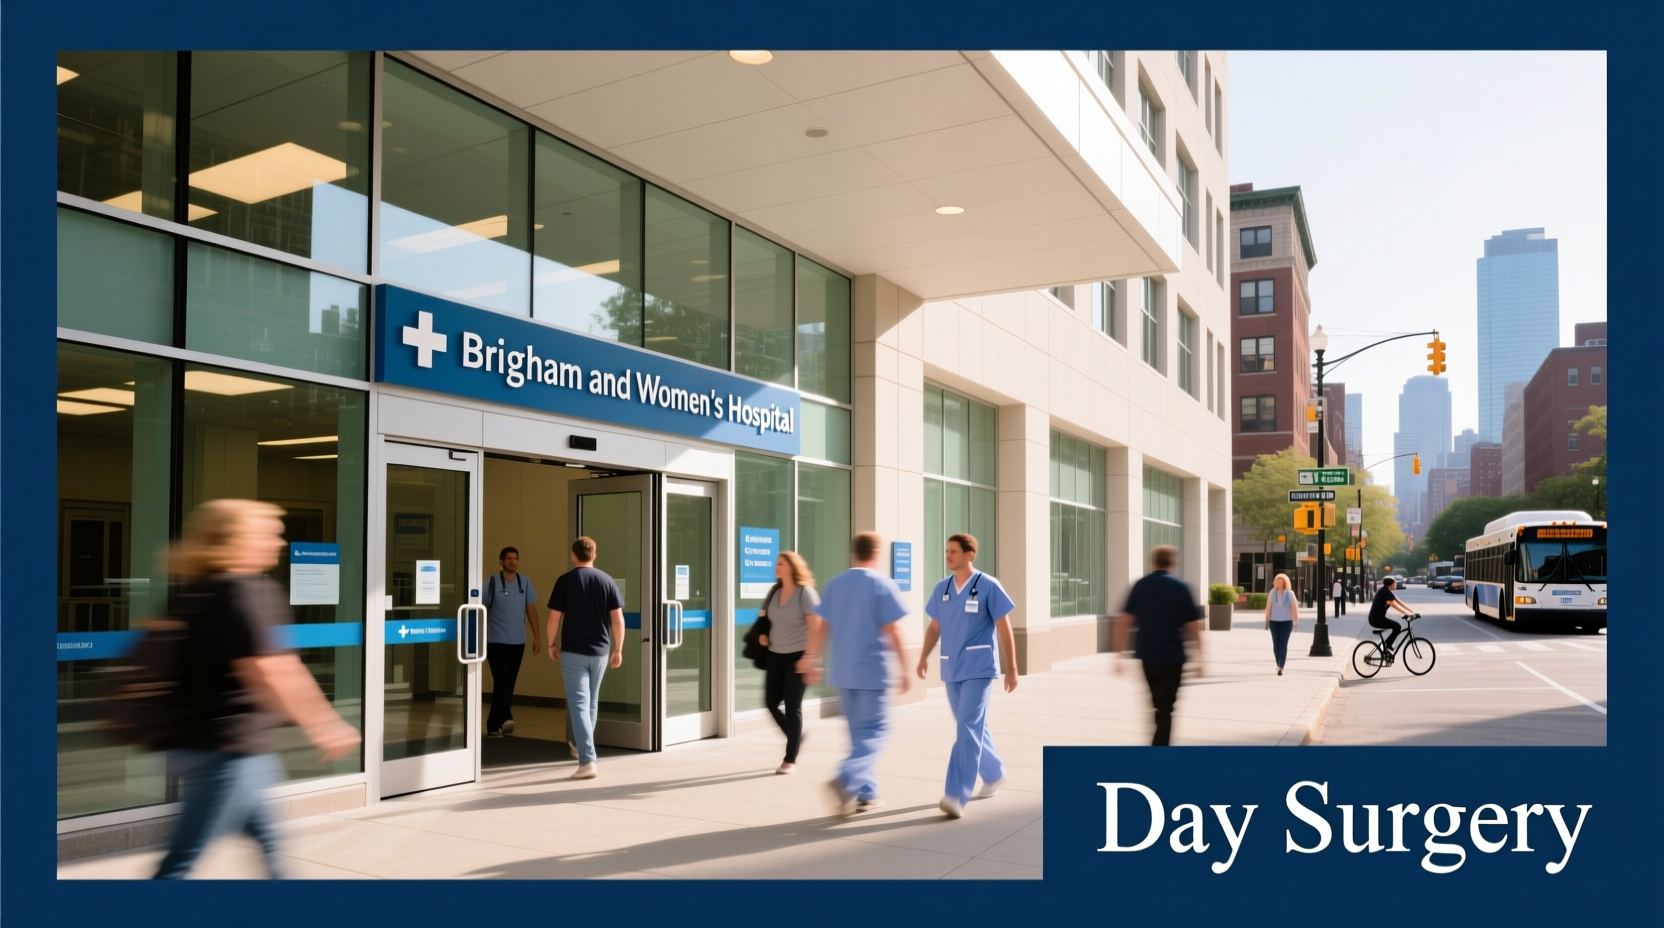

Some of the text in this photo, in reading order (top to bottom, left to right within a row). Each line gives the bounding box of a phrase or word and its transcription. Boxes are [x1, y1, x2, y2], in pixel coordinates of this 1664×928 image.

[463, 331, 794, 435] Brigham and Women's Hospital
